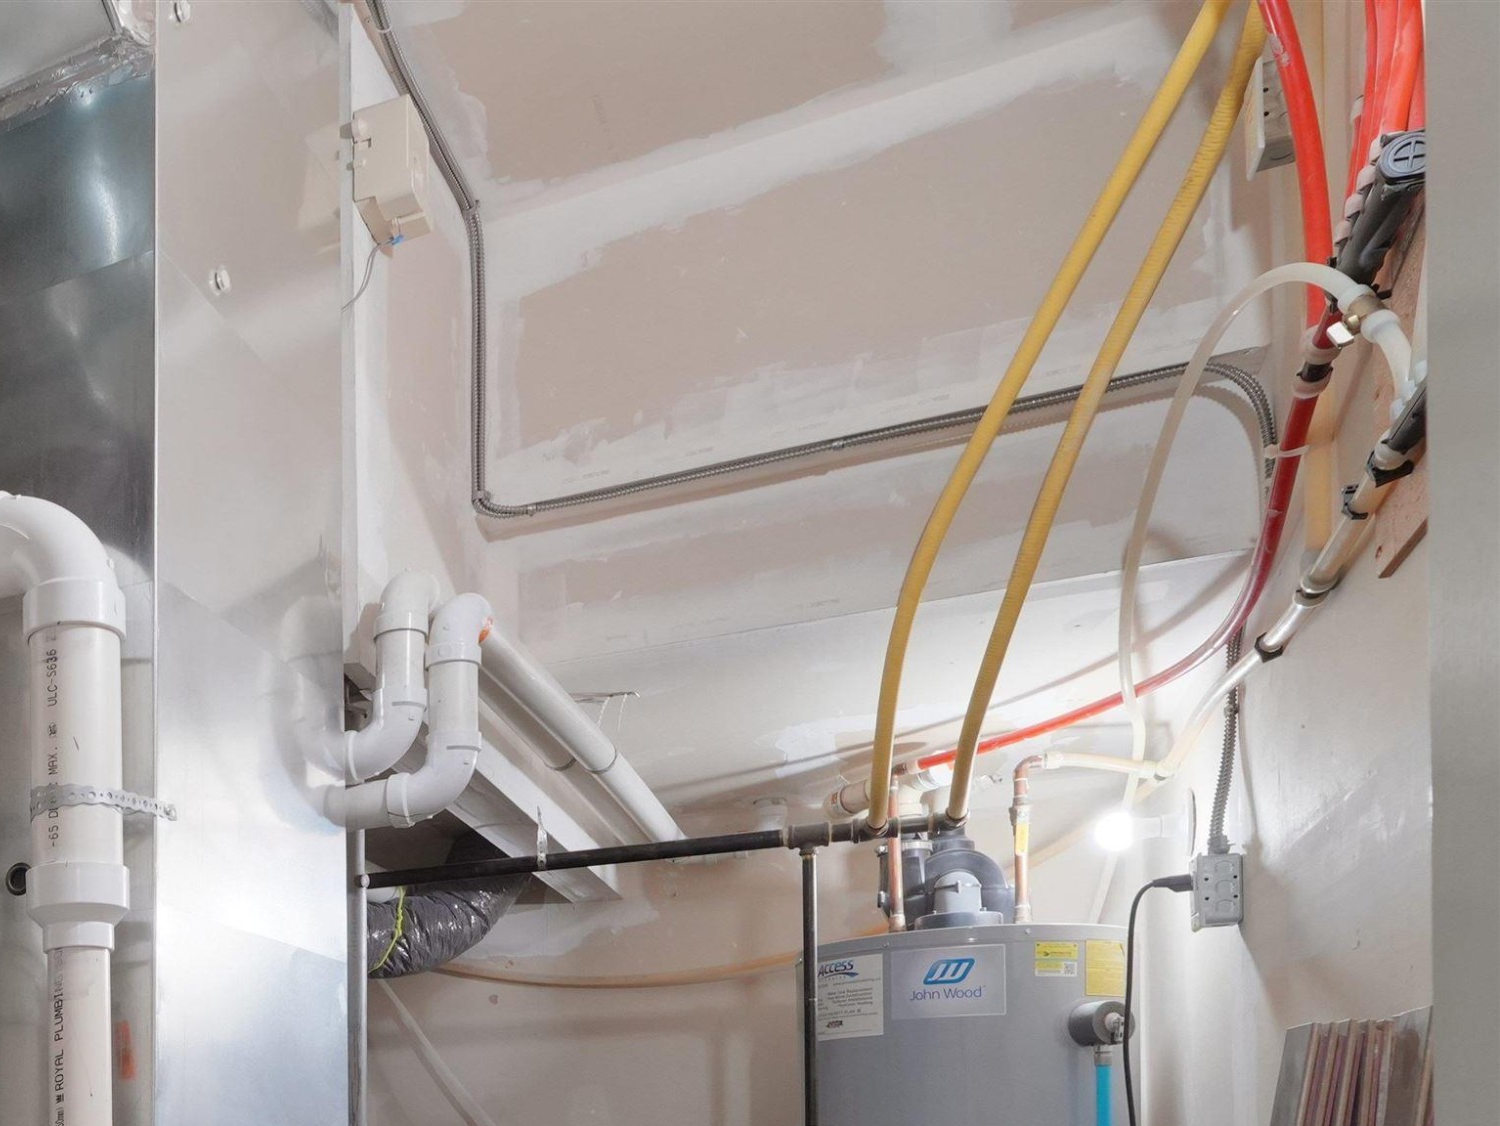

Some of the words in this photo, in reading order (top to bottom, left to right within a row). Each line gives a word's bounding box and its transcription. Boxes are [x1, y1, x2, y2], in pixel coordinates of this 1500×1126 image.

[47, 648, 57, 707] ULC-S636
[47, 746, 58, 776] MAX.
[909, 989, 941, 1001] John
[943, 986, 982, 999] Wood
[54, 1049, 64, 1091] ROYAL
